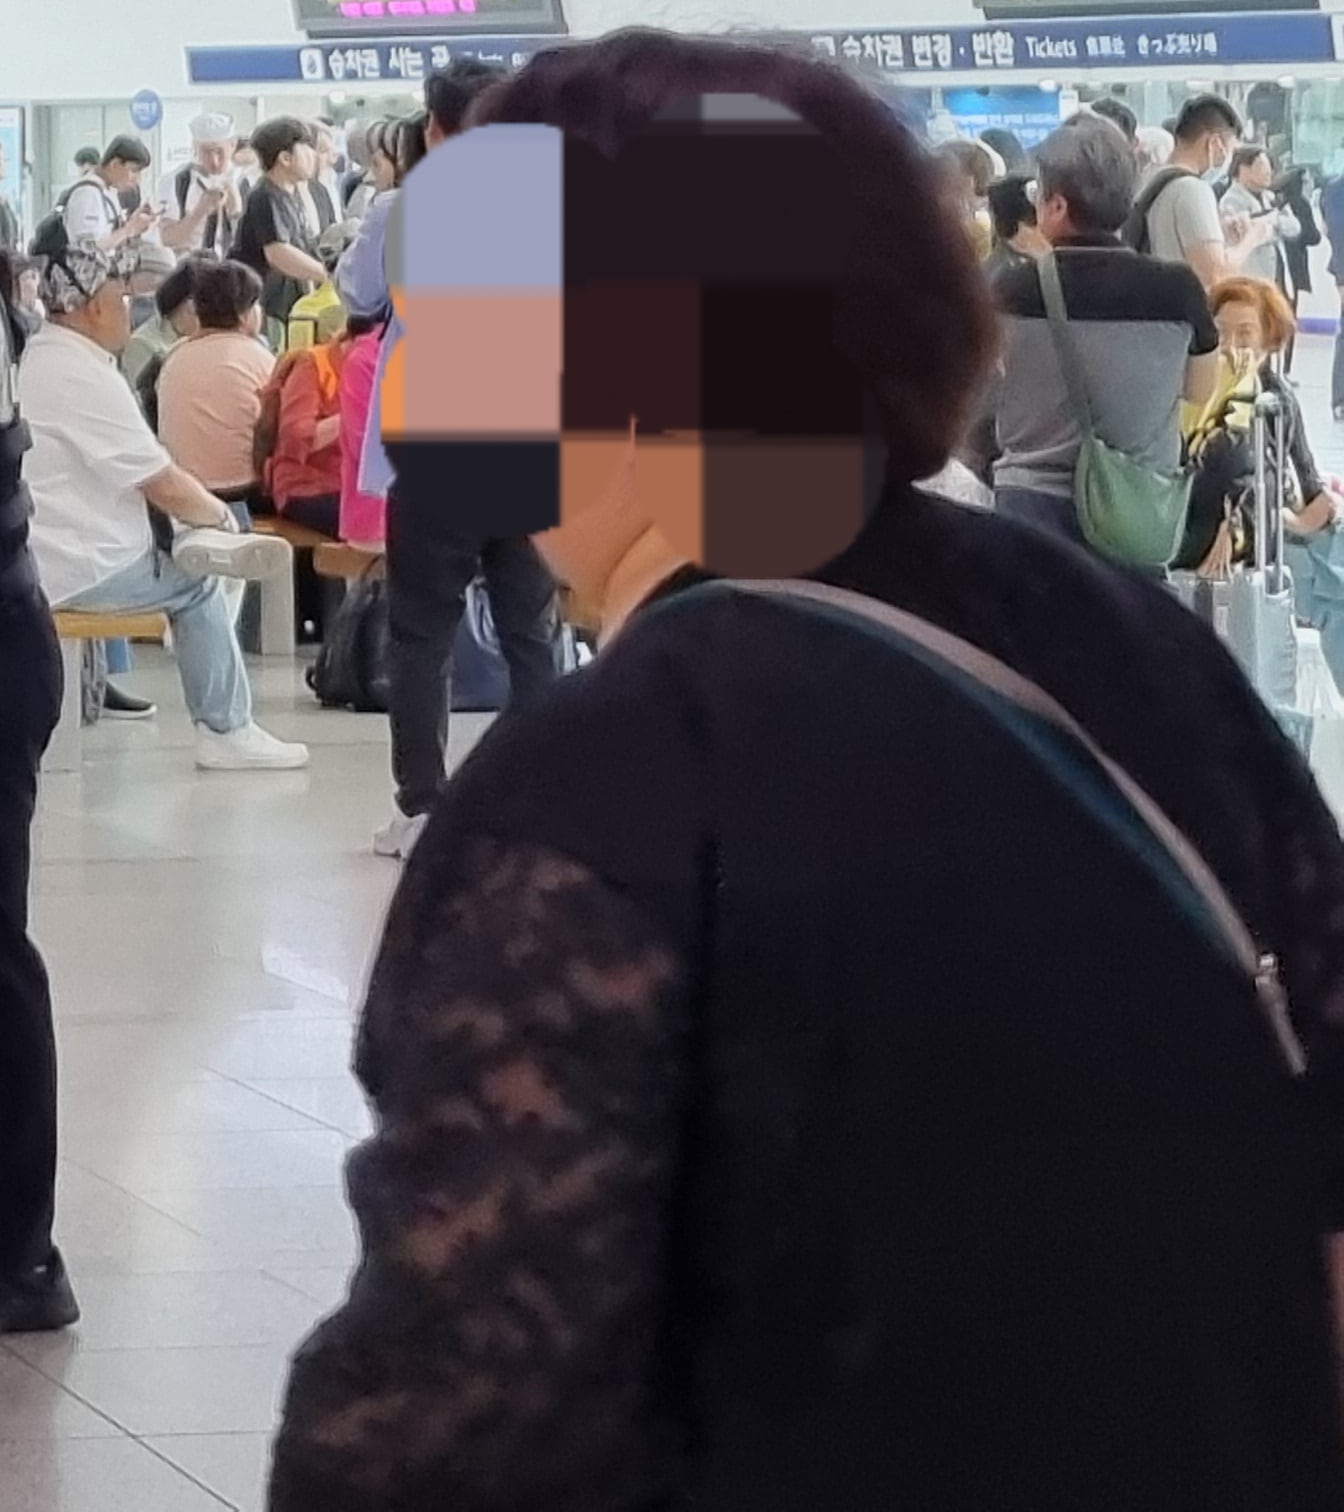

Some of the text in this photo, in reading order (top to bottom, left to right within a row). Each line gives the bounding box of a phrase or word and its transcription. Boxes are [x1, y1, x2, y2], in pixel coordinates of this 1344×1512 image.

[328, 46, 380, 80] 승차권
[389, 45, 424, 78] 사는
[912, 33, 953, 68] 변경
[972, 28, 1015, 67] 반환
[1025, 35, 1077, 59] Tickets
